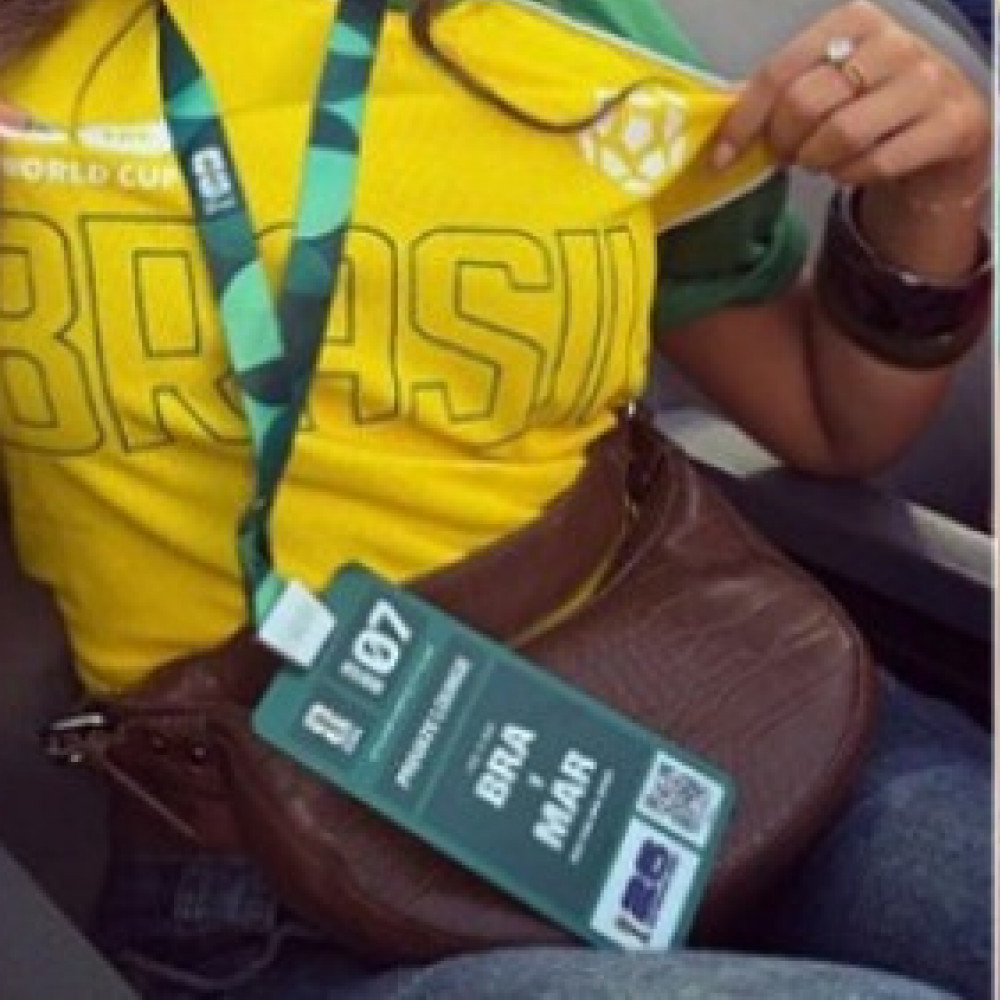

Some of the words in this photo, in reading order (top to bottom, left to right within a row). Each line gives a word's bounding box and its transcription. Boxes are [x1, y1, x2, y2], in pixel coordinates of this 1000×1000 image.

[340, 597, 412, 696] 107
[474, 722, 538, 809] BRA
[532, 748, 598, 851] MAR
